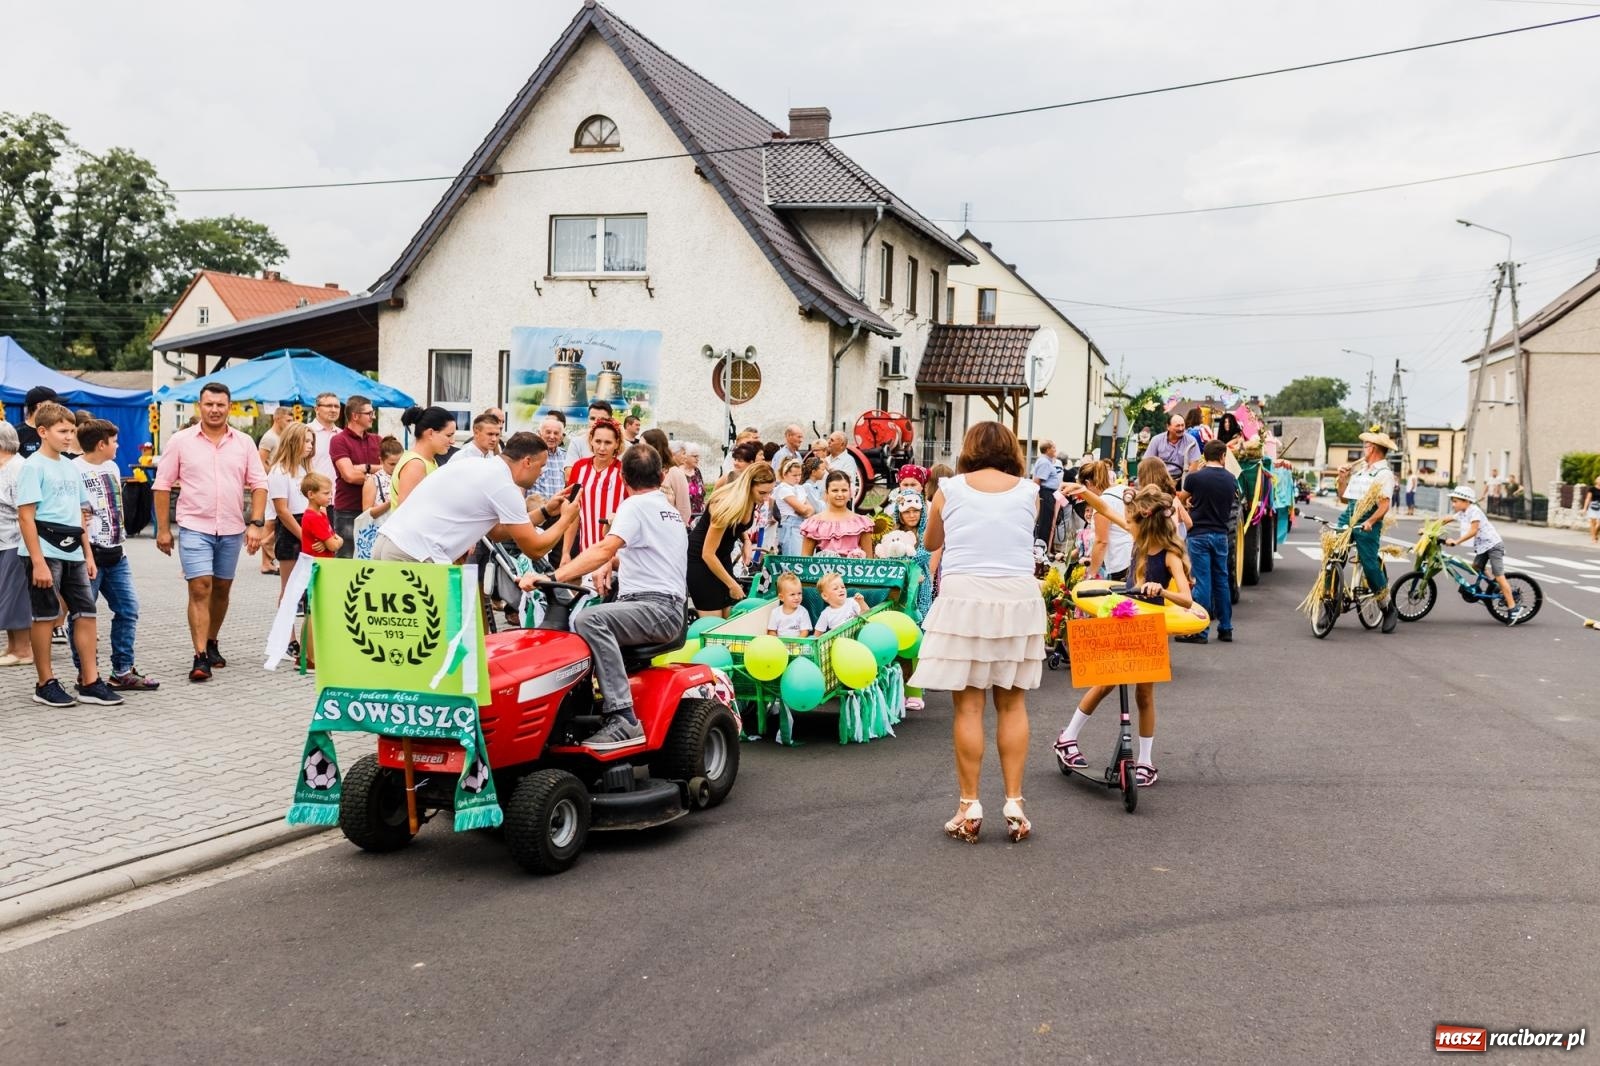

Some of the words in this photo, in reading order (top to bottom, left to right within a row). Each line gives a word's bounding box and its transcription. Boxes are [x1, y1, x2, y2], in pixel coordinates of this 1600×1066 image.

[771, 562, 804, 575] LKS
[808, 564, 906, 579] OWSISZCZE
[364, 592, 417, 614] LKS
[367, 615, 420, 628] OWSISZCZE
[384, 630, 404, 640] 1913
[358, 691, 389, 701] jeden
[383, 725, 396, 734] od
